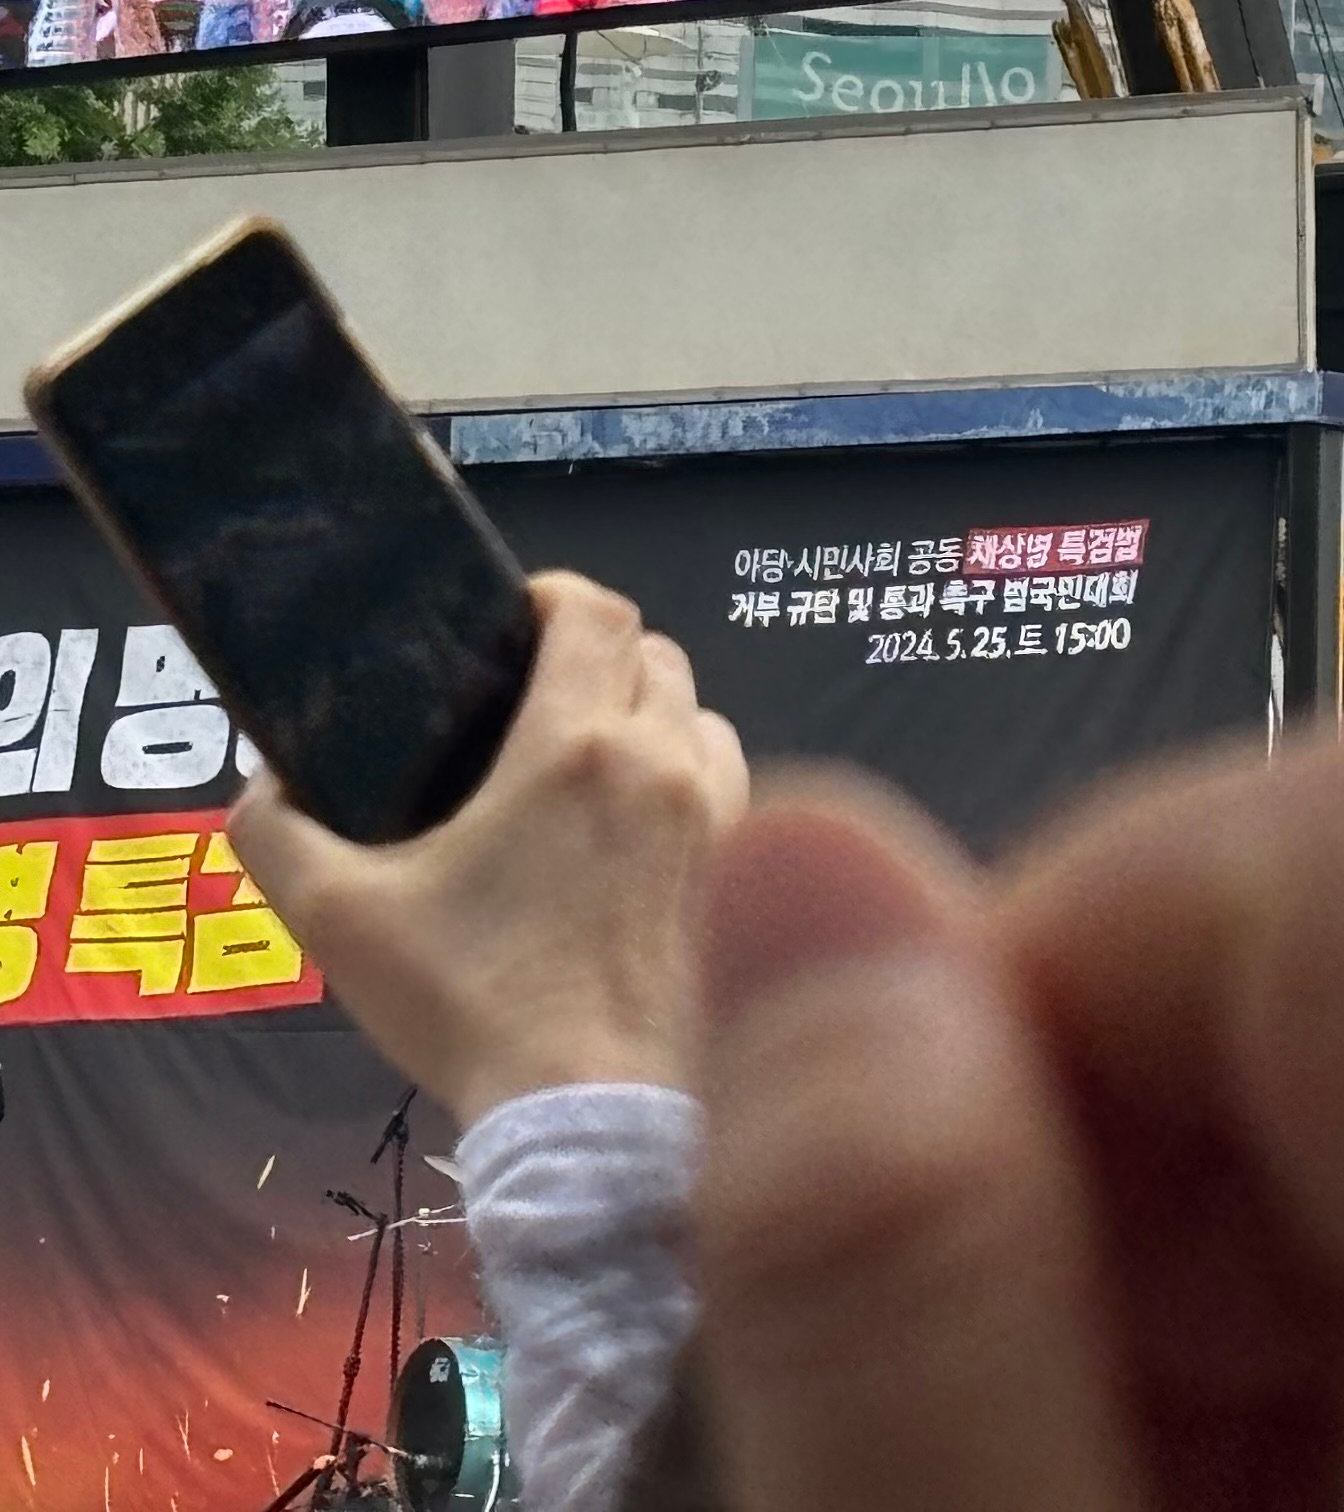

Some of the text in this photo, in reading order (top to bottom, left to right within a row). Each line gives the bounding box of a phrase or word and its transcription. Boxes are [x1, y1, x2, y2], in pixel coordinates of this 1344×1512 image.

[908, 537, 963, 576] 공동
[1057, 524, 1143, 566] 특검법
[728, 591, 781, 628] 거부
[847, 587, 874, 623] 및
[879, 582, 935, 621] 통과
[939, 579, 996, 616] 촉구
[1003, 568, 1139, 613] 범국민대회
[1056, 617, 1131, 657] 15:00
